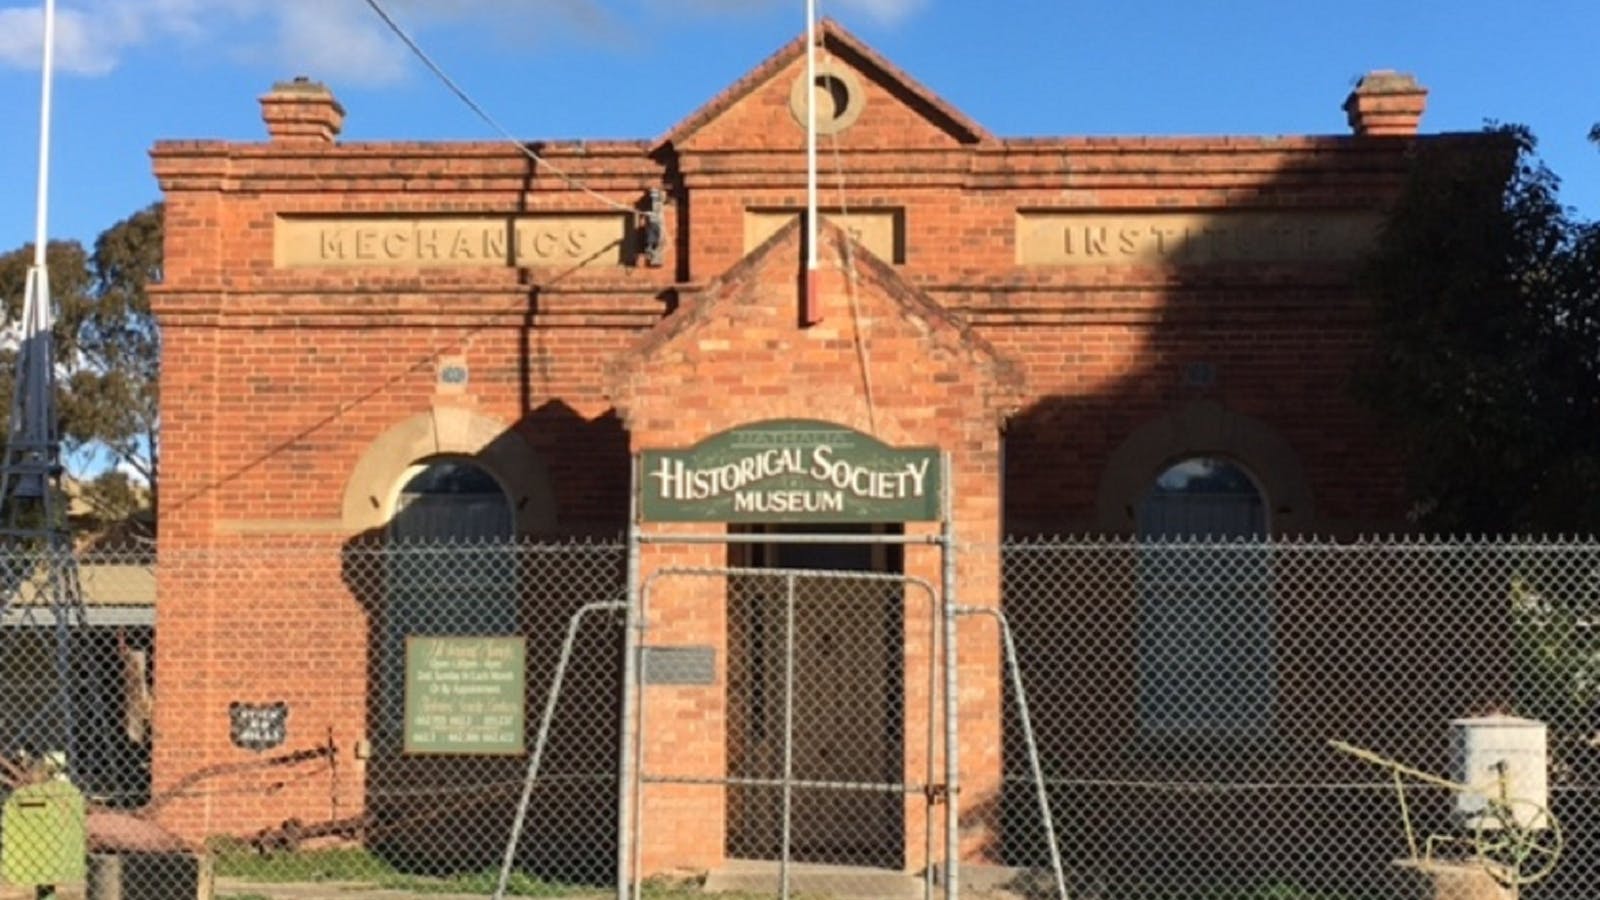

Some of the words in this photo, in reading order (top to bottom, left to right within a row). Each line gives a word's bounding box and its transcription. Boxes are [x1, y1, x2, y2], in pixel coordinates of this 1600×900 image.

[319, 228, 588, 259] MECHANICS
[1063, 226, 1321, 256] INSTITUTE
[648, 447, 809, 500] HISTORICAL
[810, 444, 930, 499] SOCIETY
[733, 489, 844, 512] MUSEUM
